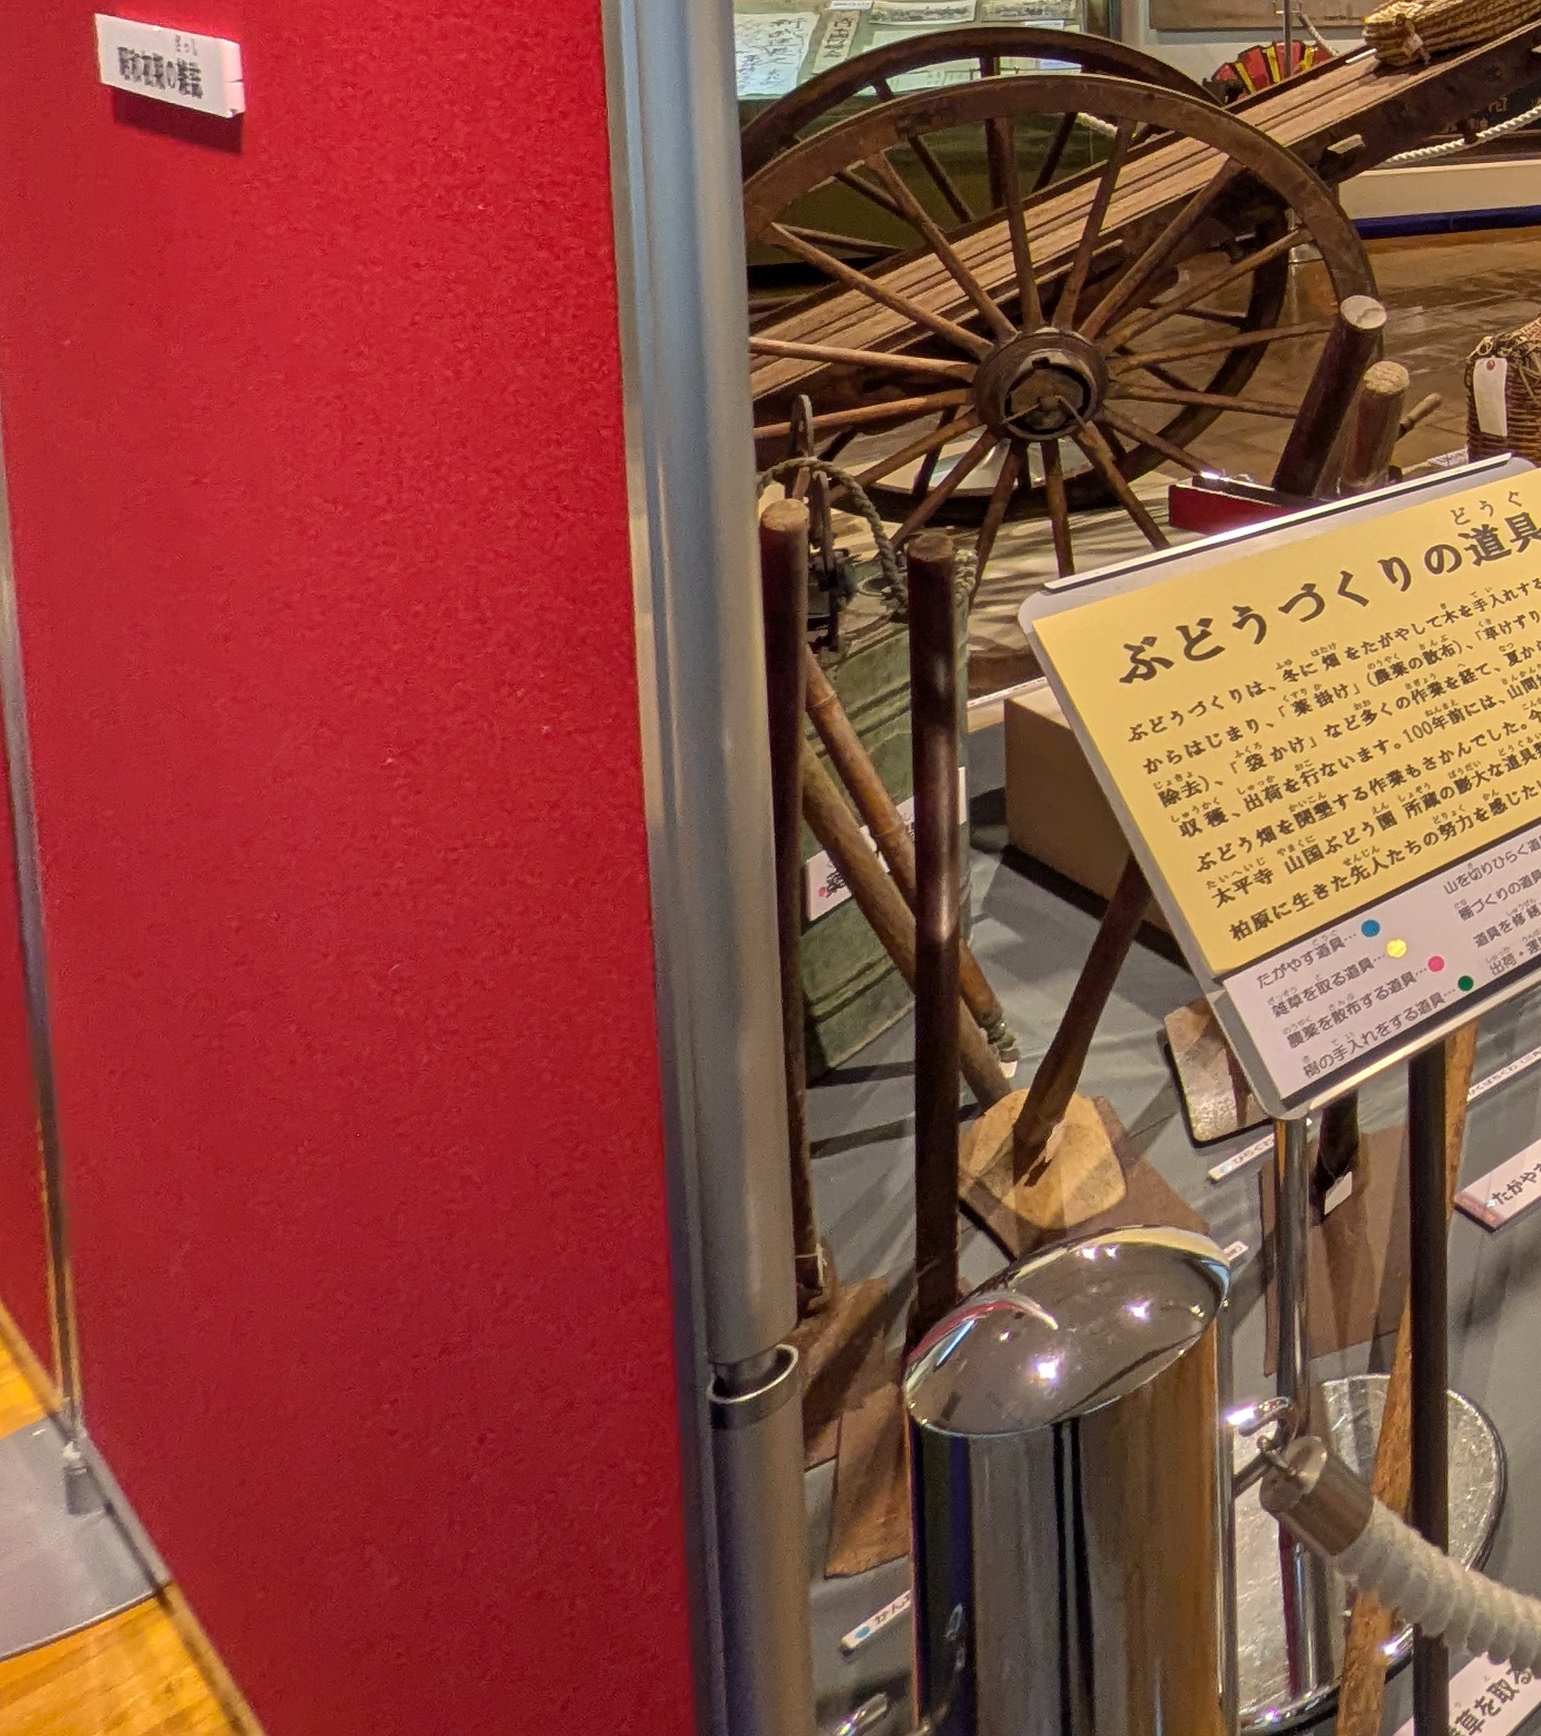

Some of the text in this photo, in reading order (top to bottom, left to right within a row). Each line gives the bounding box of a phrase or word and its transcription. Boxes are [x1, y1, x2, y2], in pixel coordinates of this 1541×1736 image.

[1449, 490, 1523, 526] どうぐ
[1210, 867, 1275, 909] 太平寺
